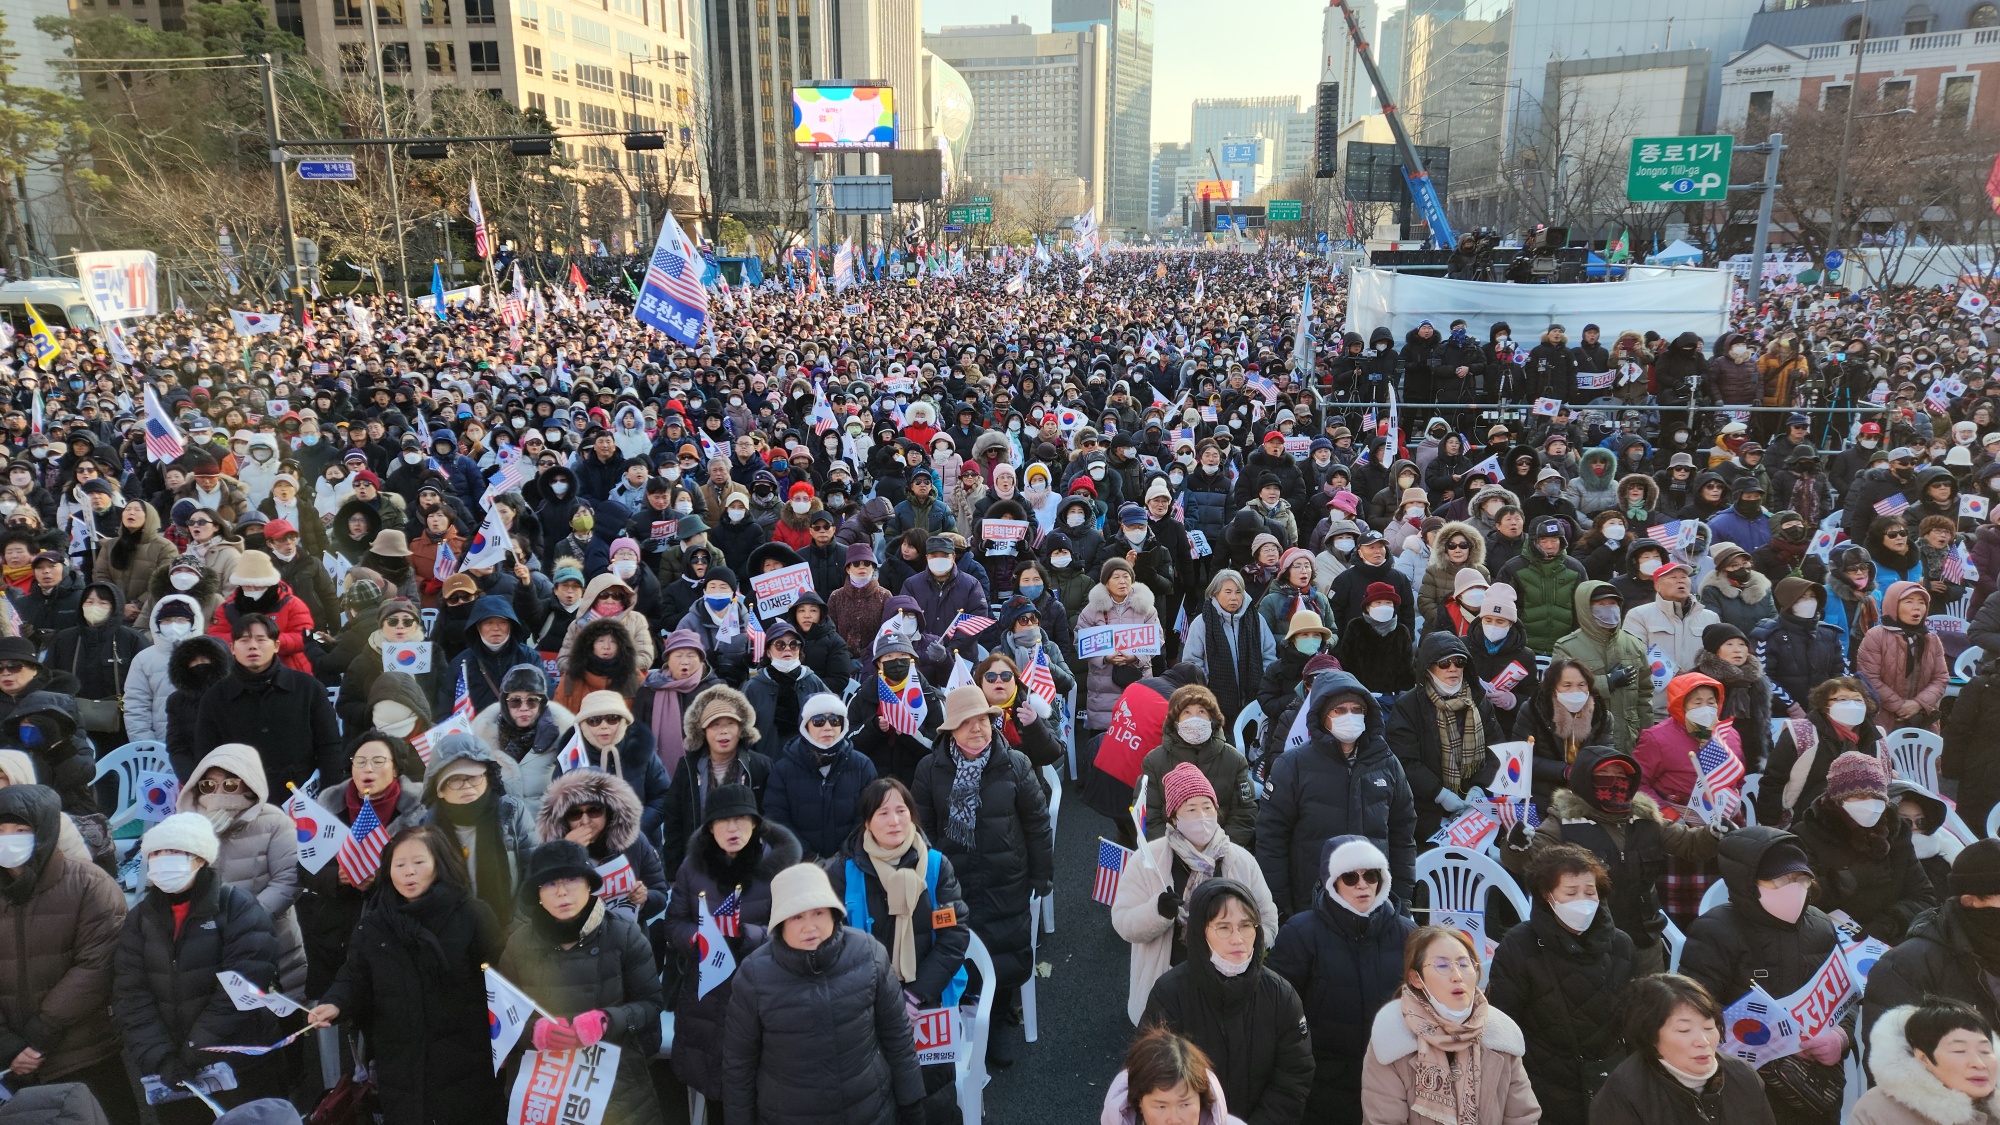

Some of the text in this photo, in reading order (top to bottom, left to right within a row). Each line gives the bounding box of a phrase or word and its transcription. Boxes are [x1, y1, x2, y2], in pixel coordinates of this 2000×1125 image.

[1227, 146, 1251, 158] 광고
[1638, 142, 1722, 163] 종로1가
[1635, 164, 1700, 178] Jongno 1(il)-ga
[1679, 181, 1688, 191] 6
[640, 293, 700, 339] 포천소흘
[757, 570, 809, 598] 탄핵반대
[760, 593, 792, 613] 이재명
[1081, 626, 1155, 656] 탄핵 저지!
[1115, 727, 1142, 751] LPG
[934, 912, 952, 925] 헌금
[1794, 960, 1848, 1037] 저지!
[918, 1051, 955, 1062] 자유통일당
